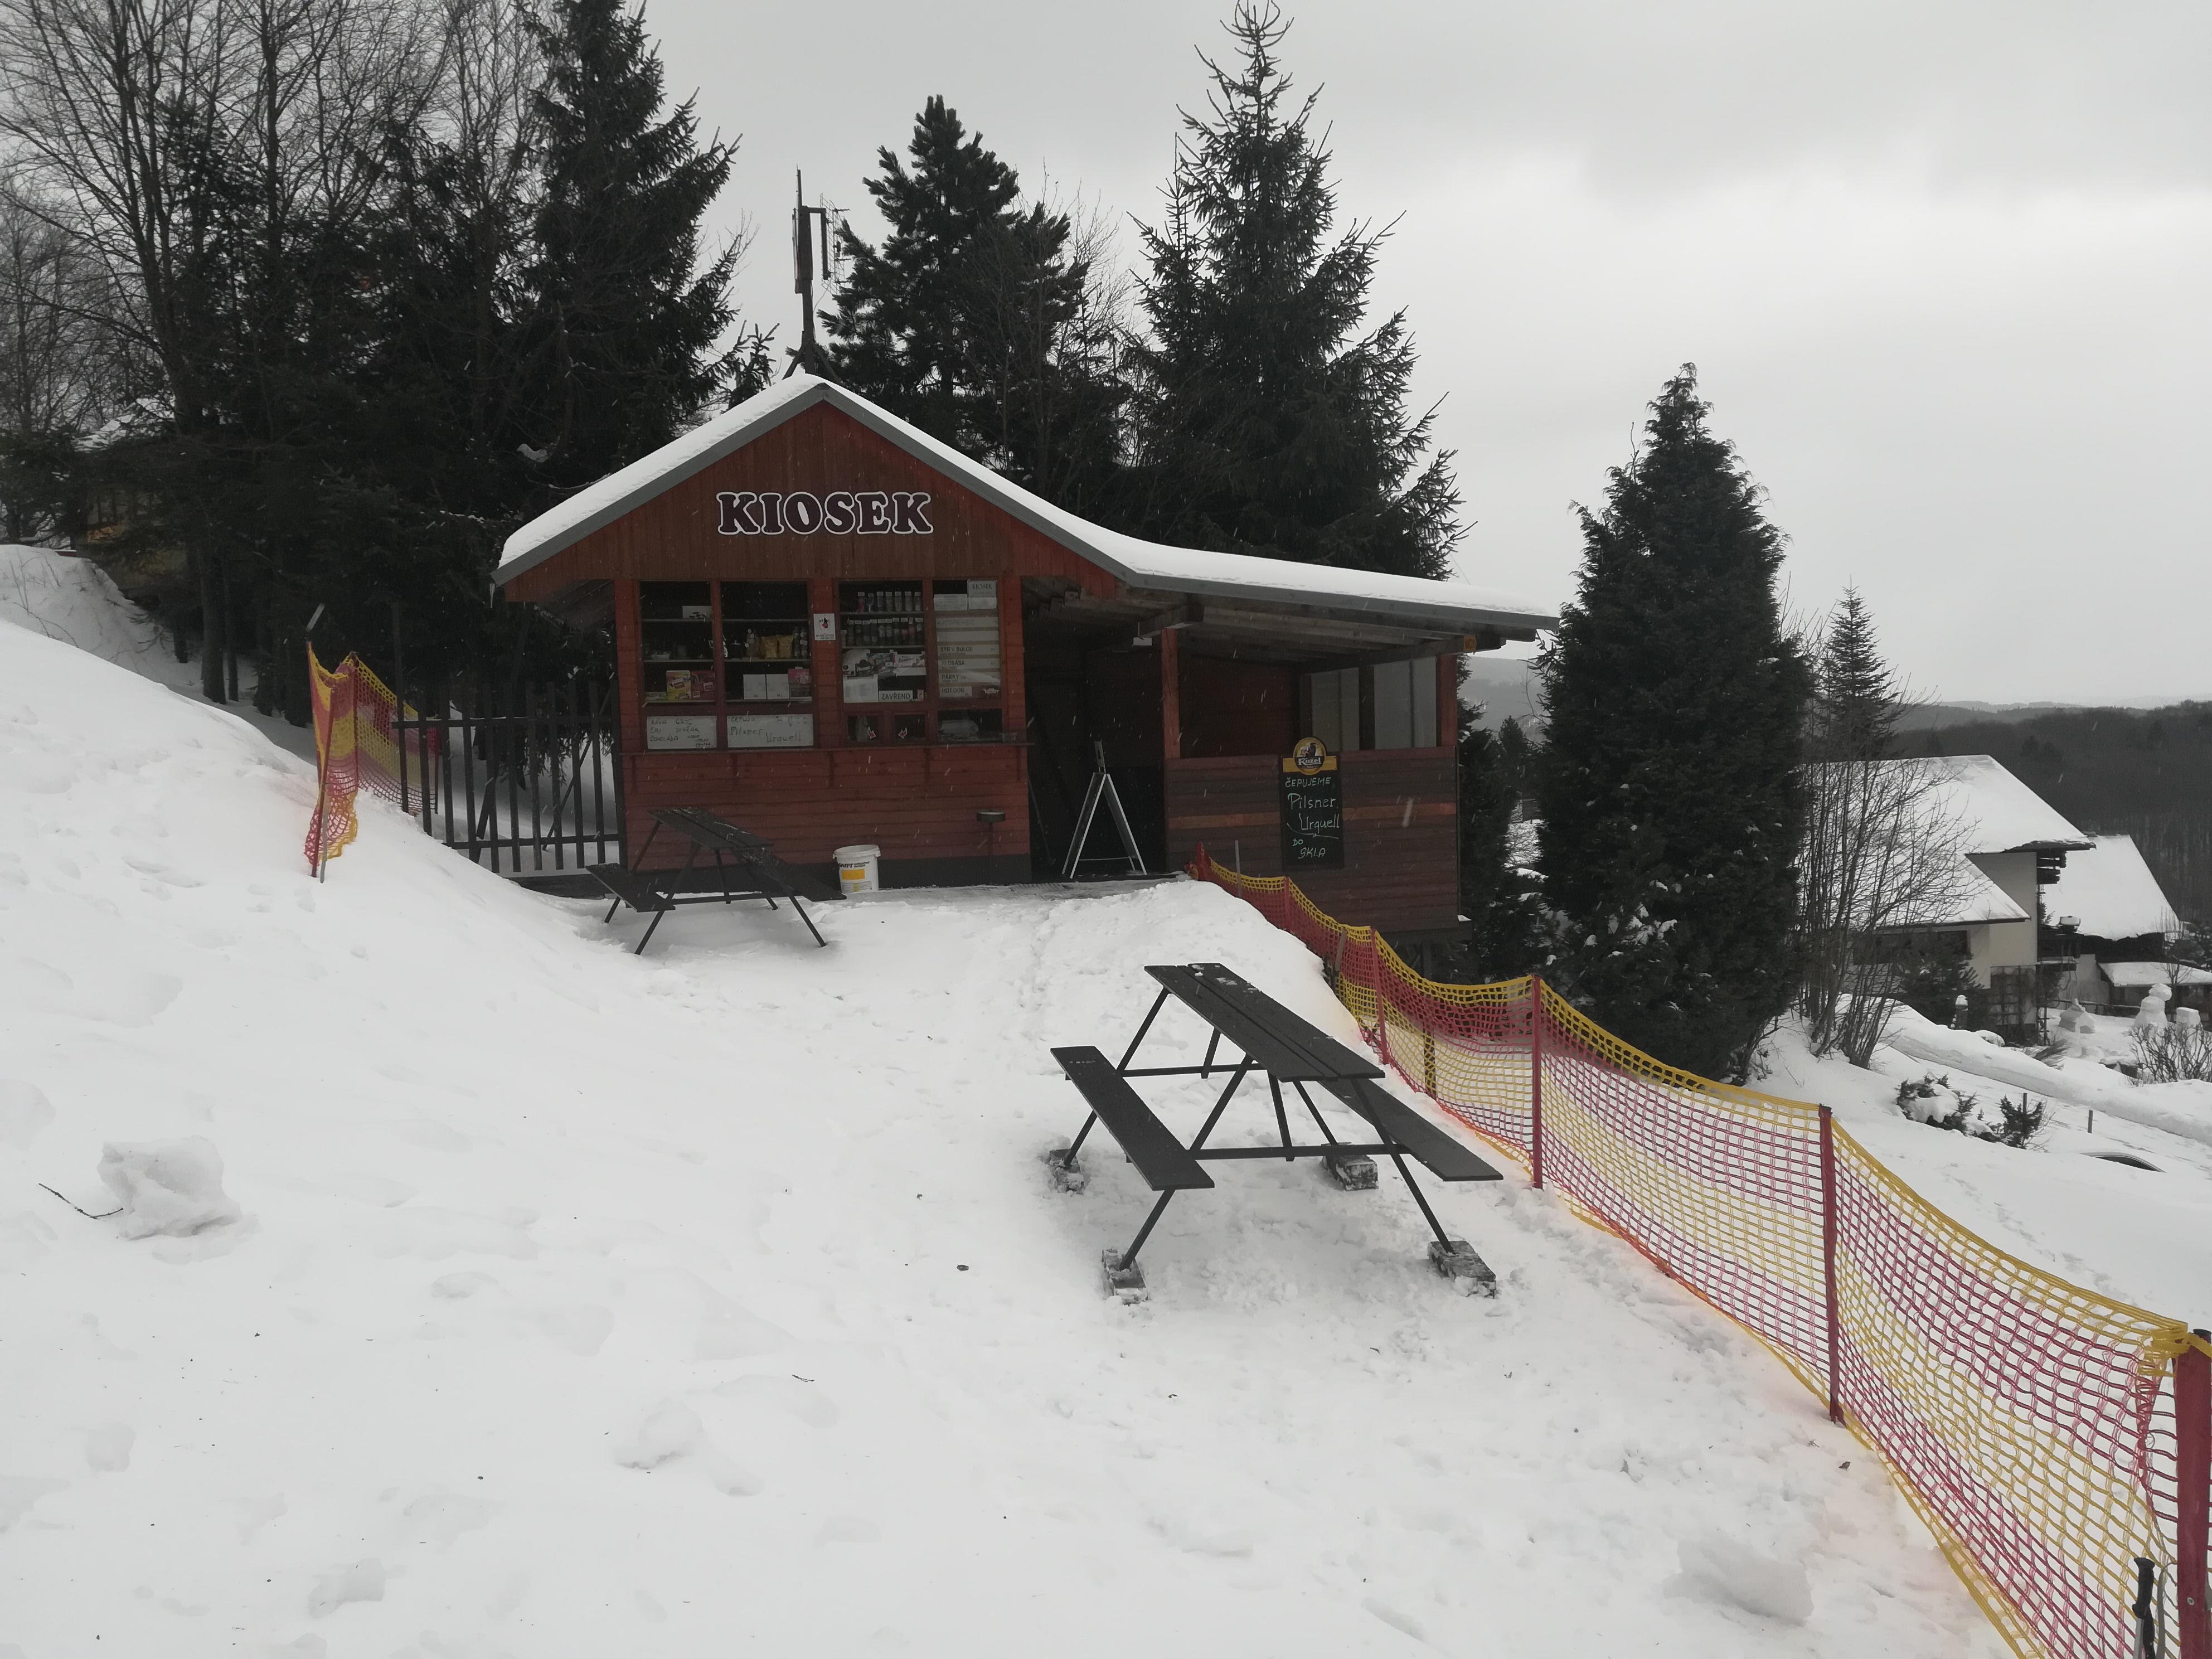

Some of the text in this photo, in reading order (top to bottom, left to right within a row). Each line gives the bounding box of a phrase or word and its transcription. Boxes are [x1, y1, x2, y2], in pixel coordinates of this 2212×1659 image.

[716, 491, 934, 535] KIOSEK
[881, 692, 910, 700] ZAVŘENO
[1298, 757, 1321, 766] Kozel
[1287, 793, 1336, 810] Pilsner
[1298, 813, 1340, 834] Urquell
[1292, 838, 1303, 847] DO
[1297, 847, 1326, 860] SKLA
